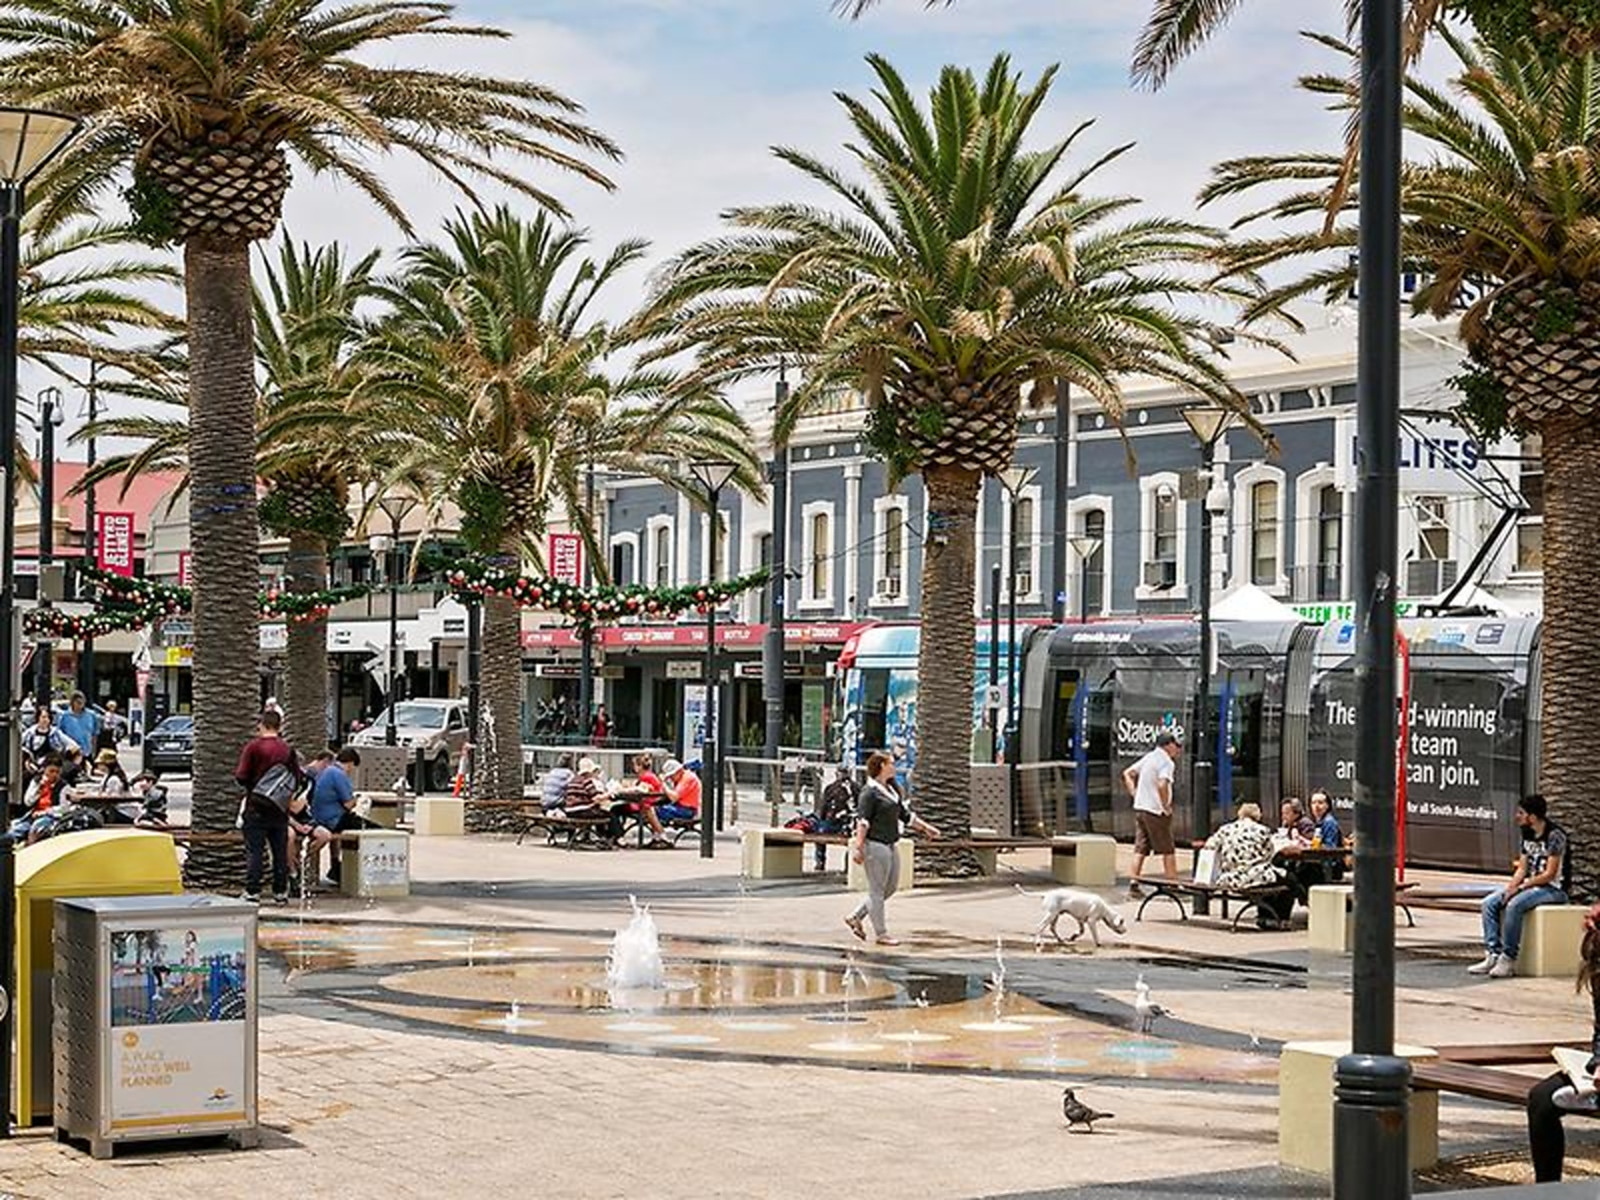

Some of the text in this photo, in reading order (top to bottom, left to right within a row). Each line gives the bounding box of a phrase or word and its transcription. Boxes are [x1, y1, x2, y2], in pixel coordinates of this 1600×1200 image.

[1352, 436, 1479, 471] LITES
[1326, 700, 1497, 735] The d-winning
[1411, 733, 1458, 757] team
[1336, 760, 1357, 780] an
[1439, 760, 1480, 790] join.
